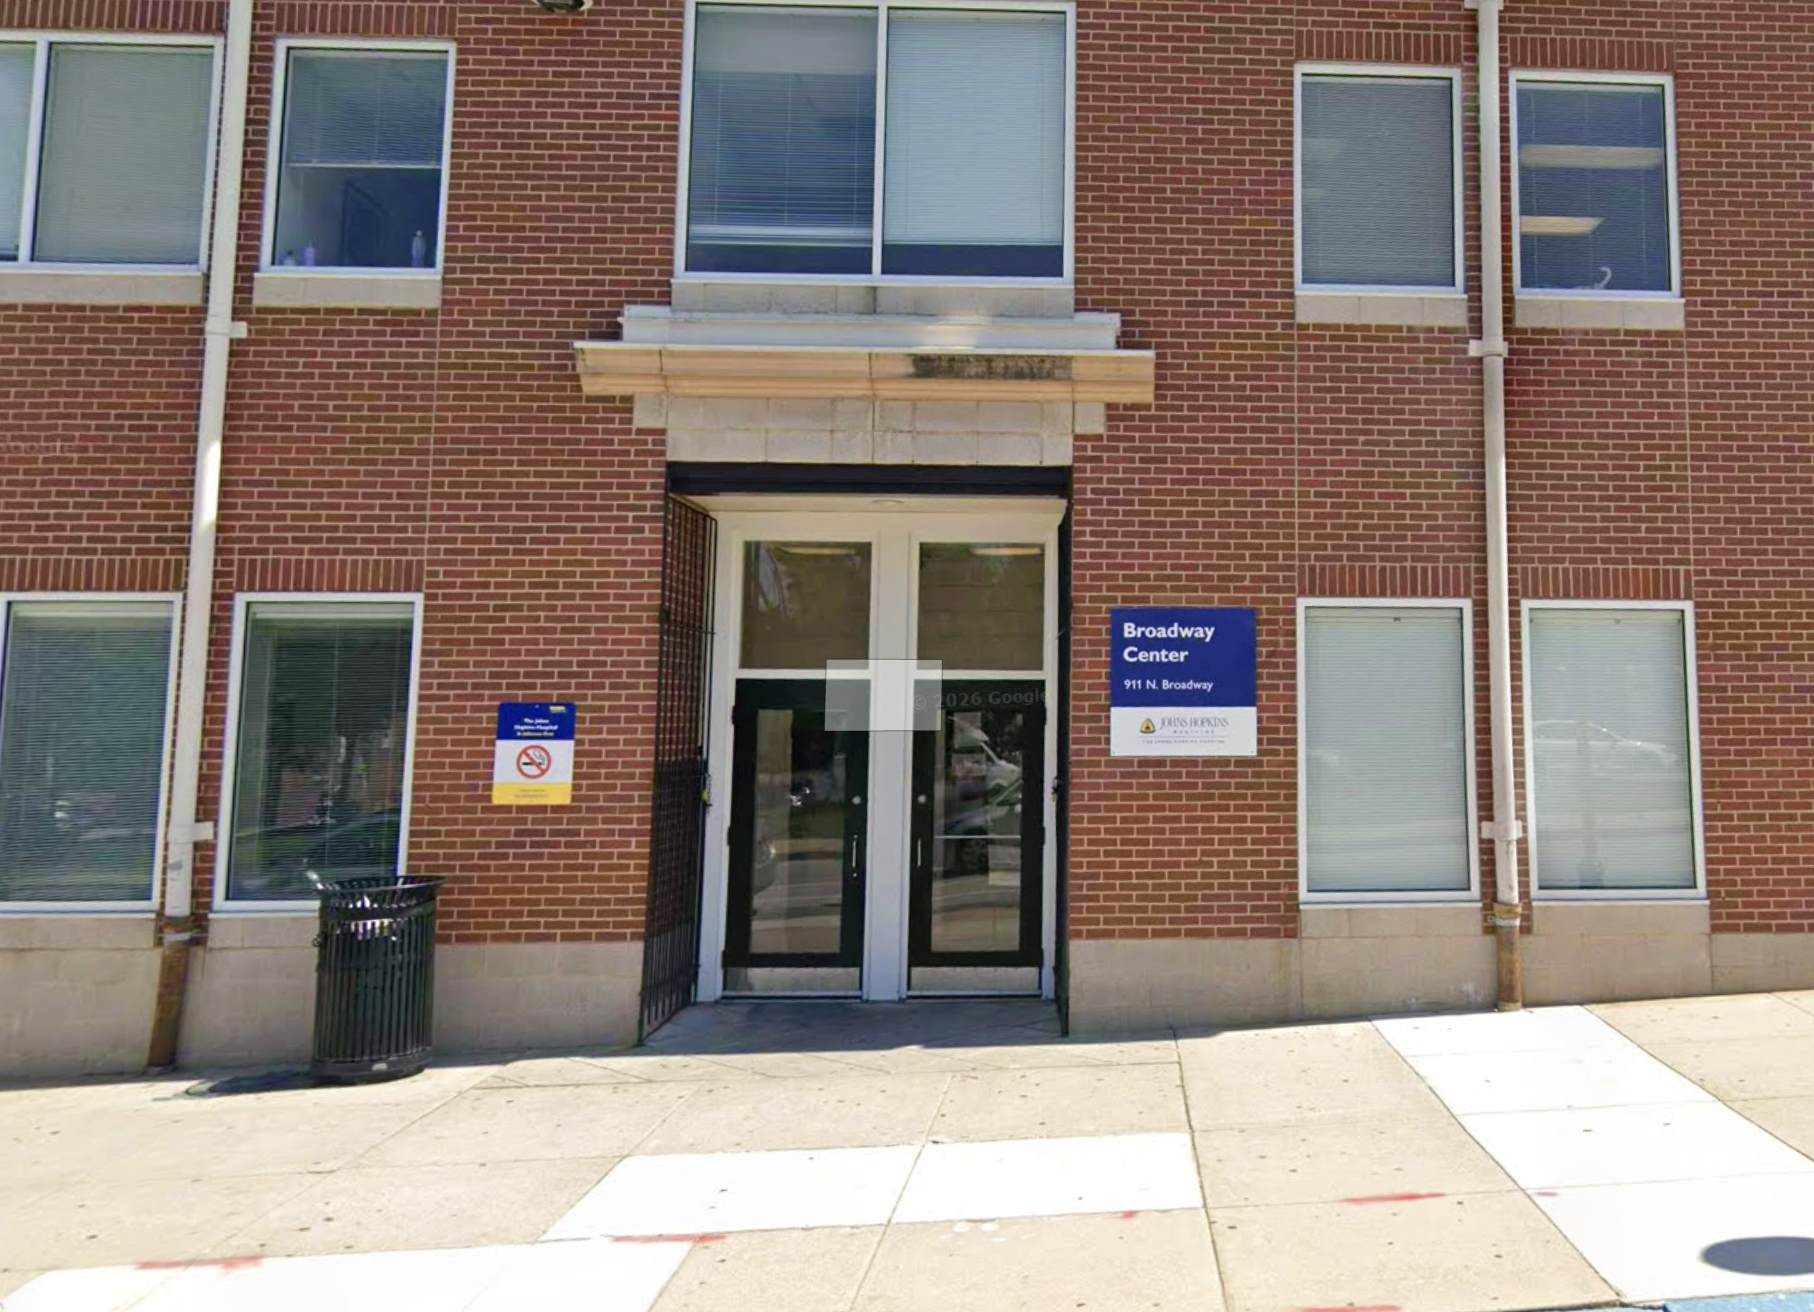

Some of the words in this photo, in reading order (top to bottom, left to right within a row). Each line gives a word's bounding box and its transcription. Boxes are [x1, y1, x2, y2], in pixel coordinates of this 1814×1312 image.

[1123, 622, 1215, 642] Broadway
[1123, 646, 1189, 662] Center
[1124, 679, 1142, 690] 911
[1146, 679, 1158, 690] N.
[1162, 679, 1213, 692] Broadway
[1160, 717, 1188, 729] JOHNS
[1190, 716, 1229, 728] HOPKINS
